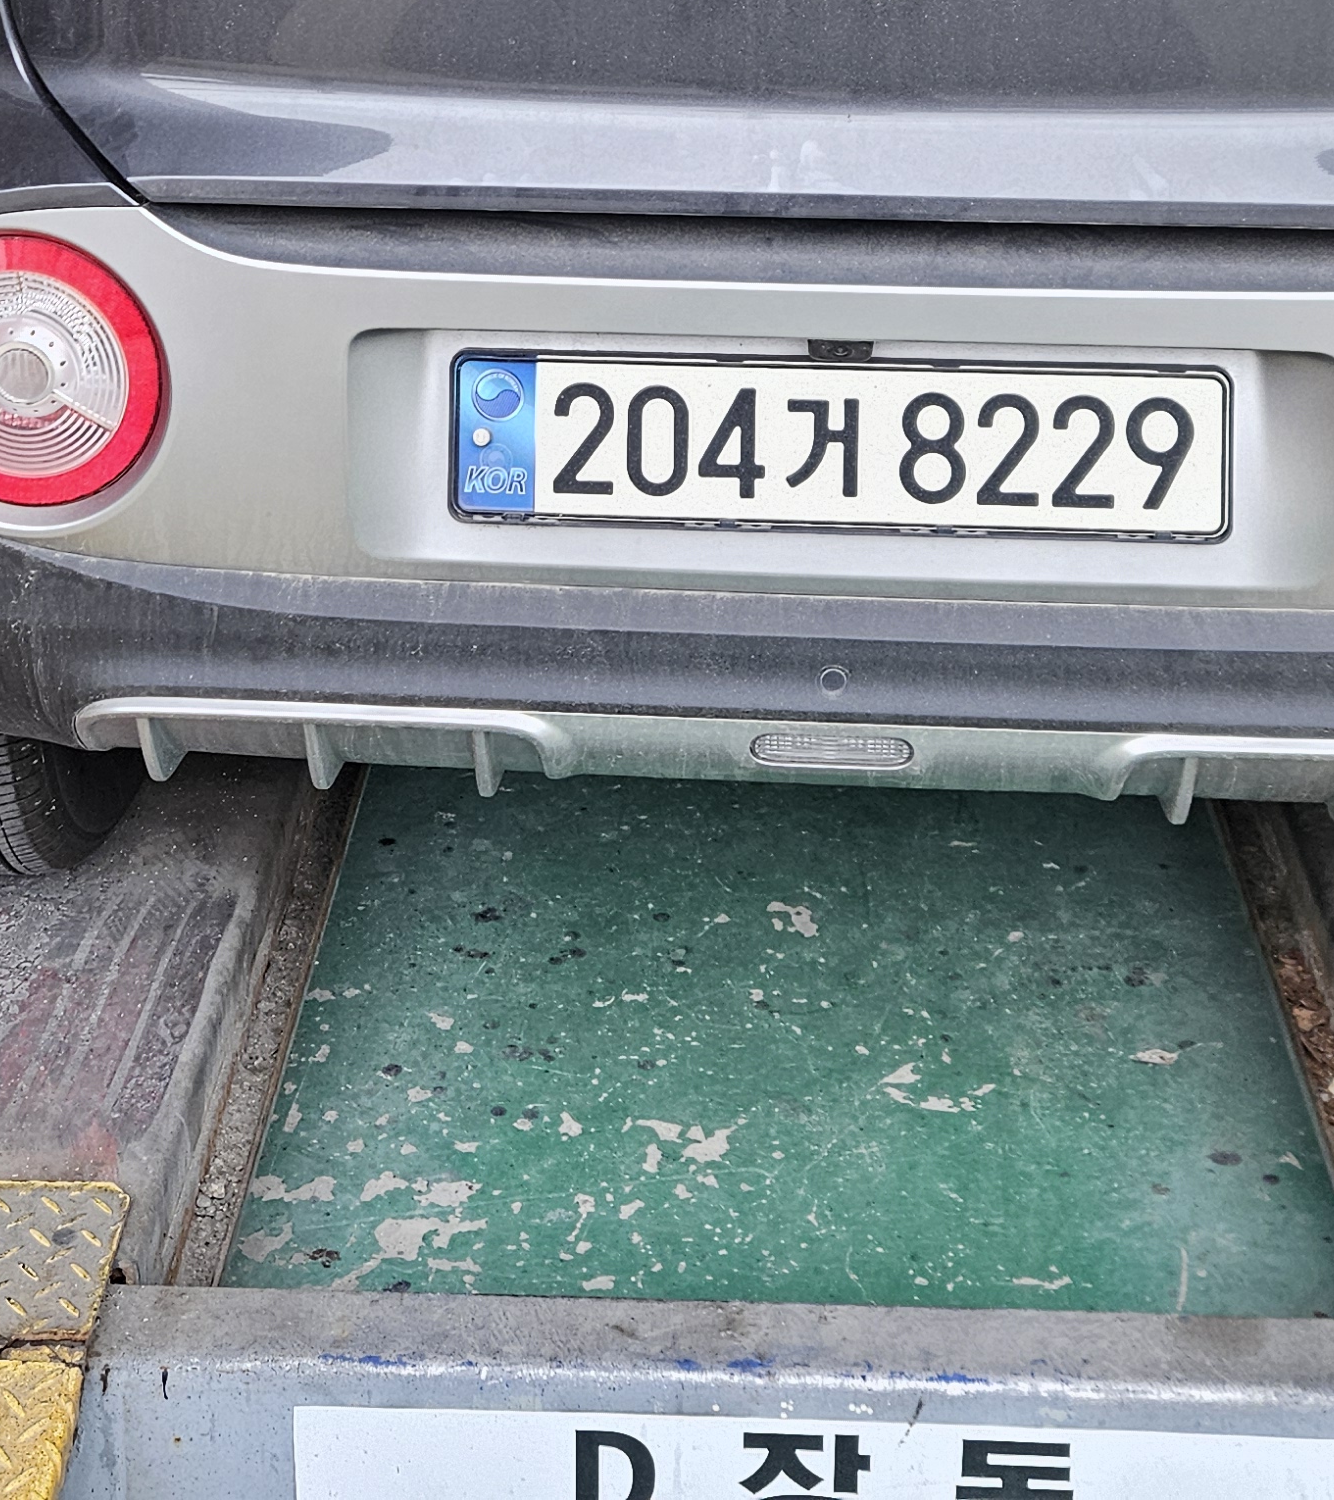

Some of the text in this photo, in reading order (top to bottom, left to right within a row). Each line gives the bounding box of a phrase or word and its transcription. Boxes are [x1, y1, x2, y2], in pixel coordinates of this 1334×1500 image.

[464, 465, 528, 495] KOR
[553, 382, 1196, 511] 204거 8229
